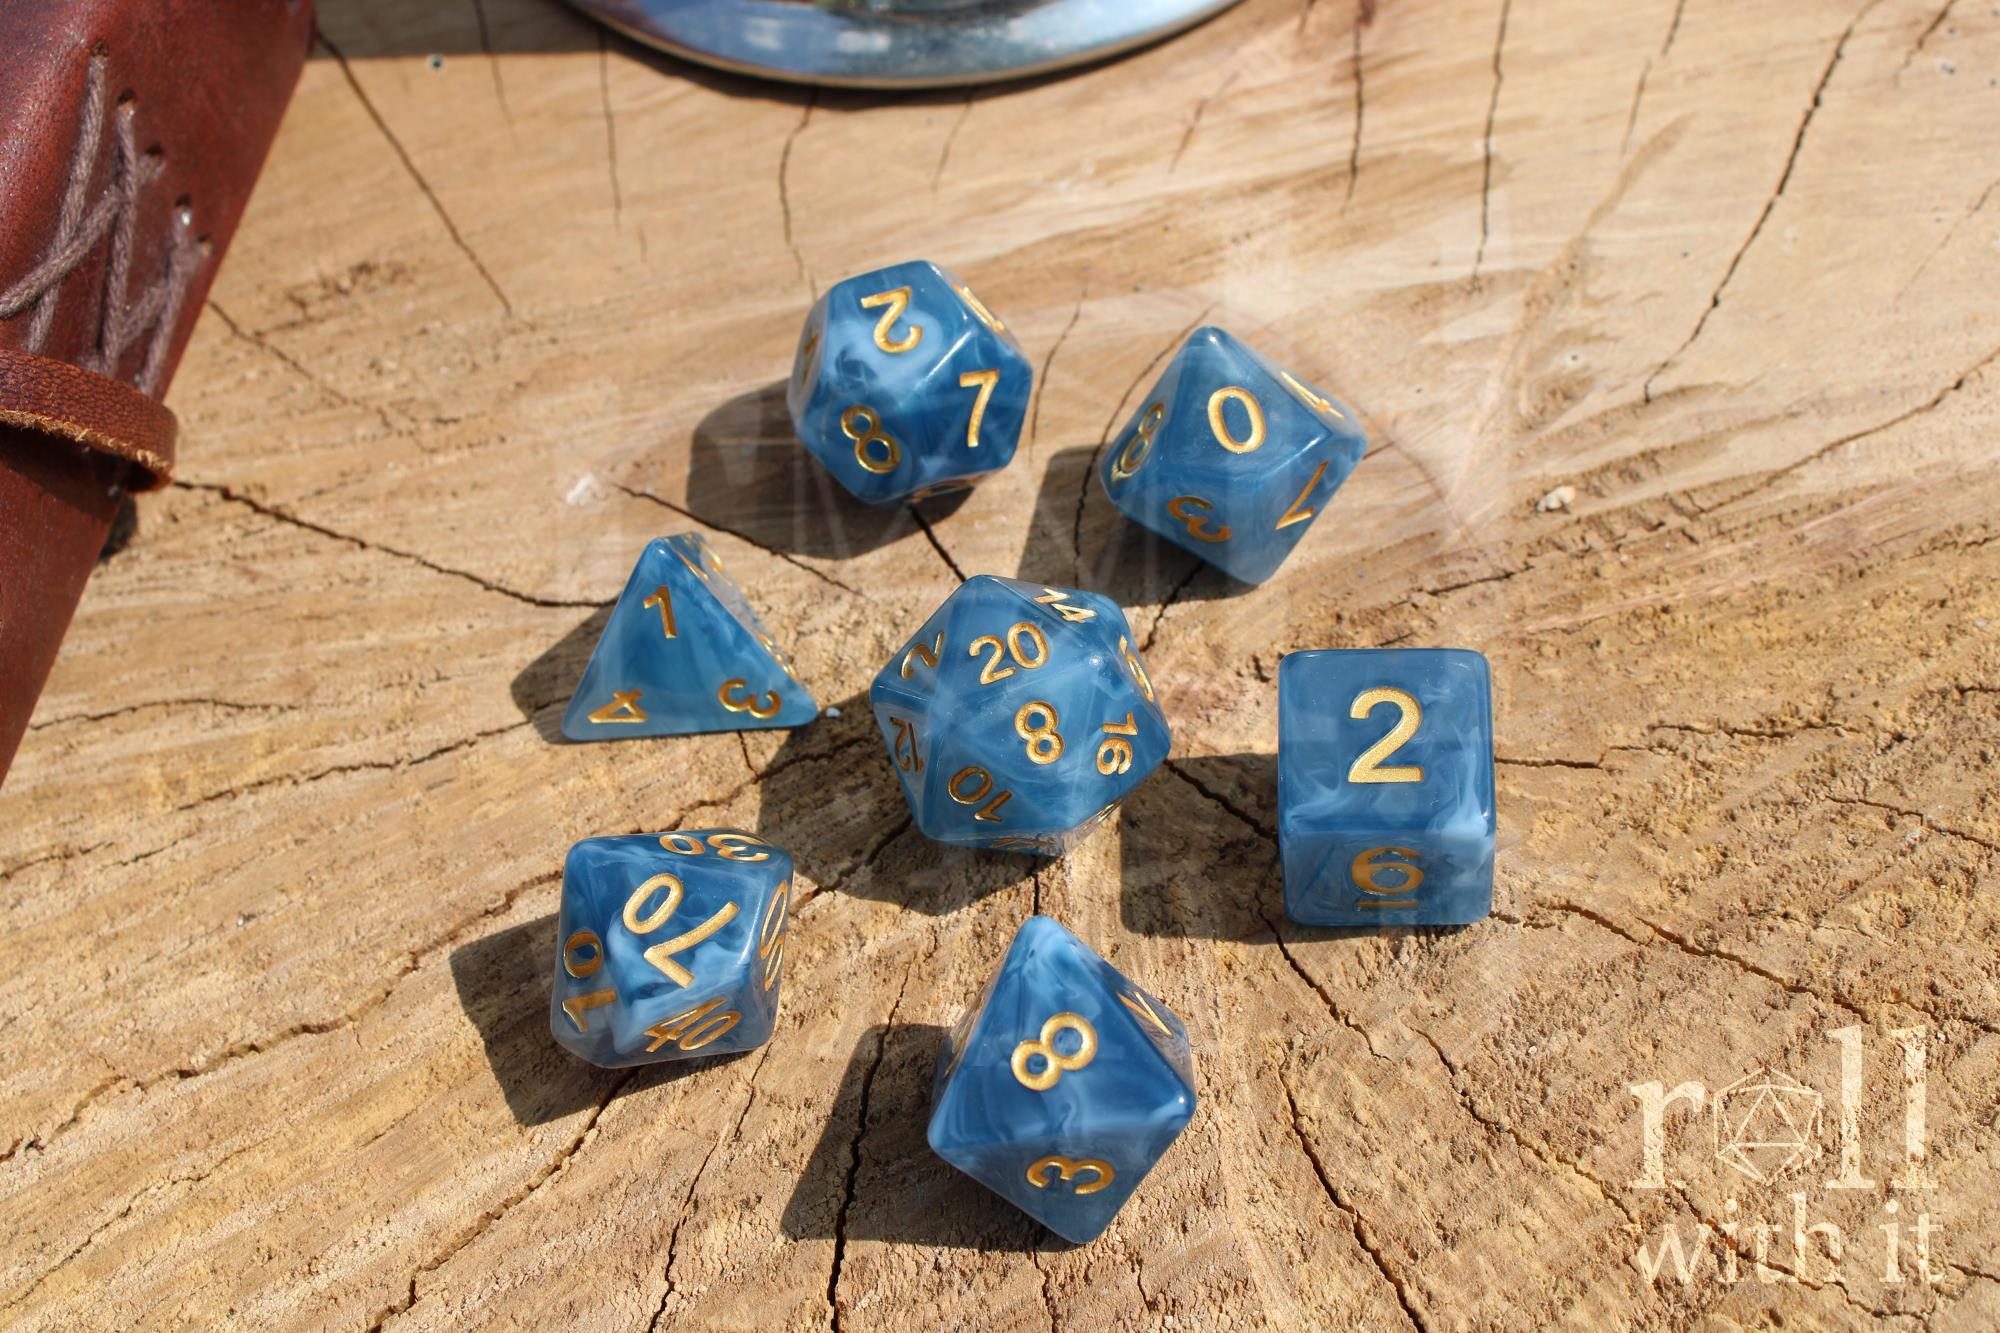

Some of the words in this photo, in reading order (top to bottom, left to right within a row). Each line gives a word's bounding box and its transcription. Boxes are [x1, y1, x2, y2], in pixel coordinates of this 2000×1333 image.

[861, 285, 923, 353] 2
[841, 404, 900, 474] 8
[959, 368, 999, 447] 7
[1119, 401, 1165, 473] 8
[1207, 386, 1267, 454] 0
[1167, 495, 1233, 542] 3
[643, 585, 678, 639] 1
[1034, 588, 1098, 624] 14
[901, 631, 945, 680] 2
[968, 622, 1049, 685] 20
[588, 689, 648, 723] 4
[718, 678, 781, 719] 3
[889, 716, 924, 773] 12
[1014, 701, 1065, 765] 8
[1096, 712, 1139, 776] 16
[1348, 687, 1425, 783] 2
[948, 766, 1014, 823] 10
[659, 833, 770, 861] 30
[623, 873, 741, 989] 70
[562, 931, 617, 1033] 10
[643, 997, 742, 1053] 40
[1010, 1012, 1098, 1091] 8
[1026, 1156, 1116, 1195] 3
